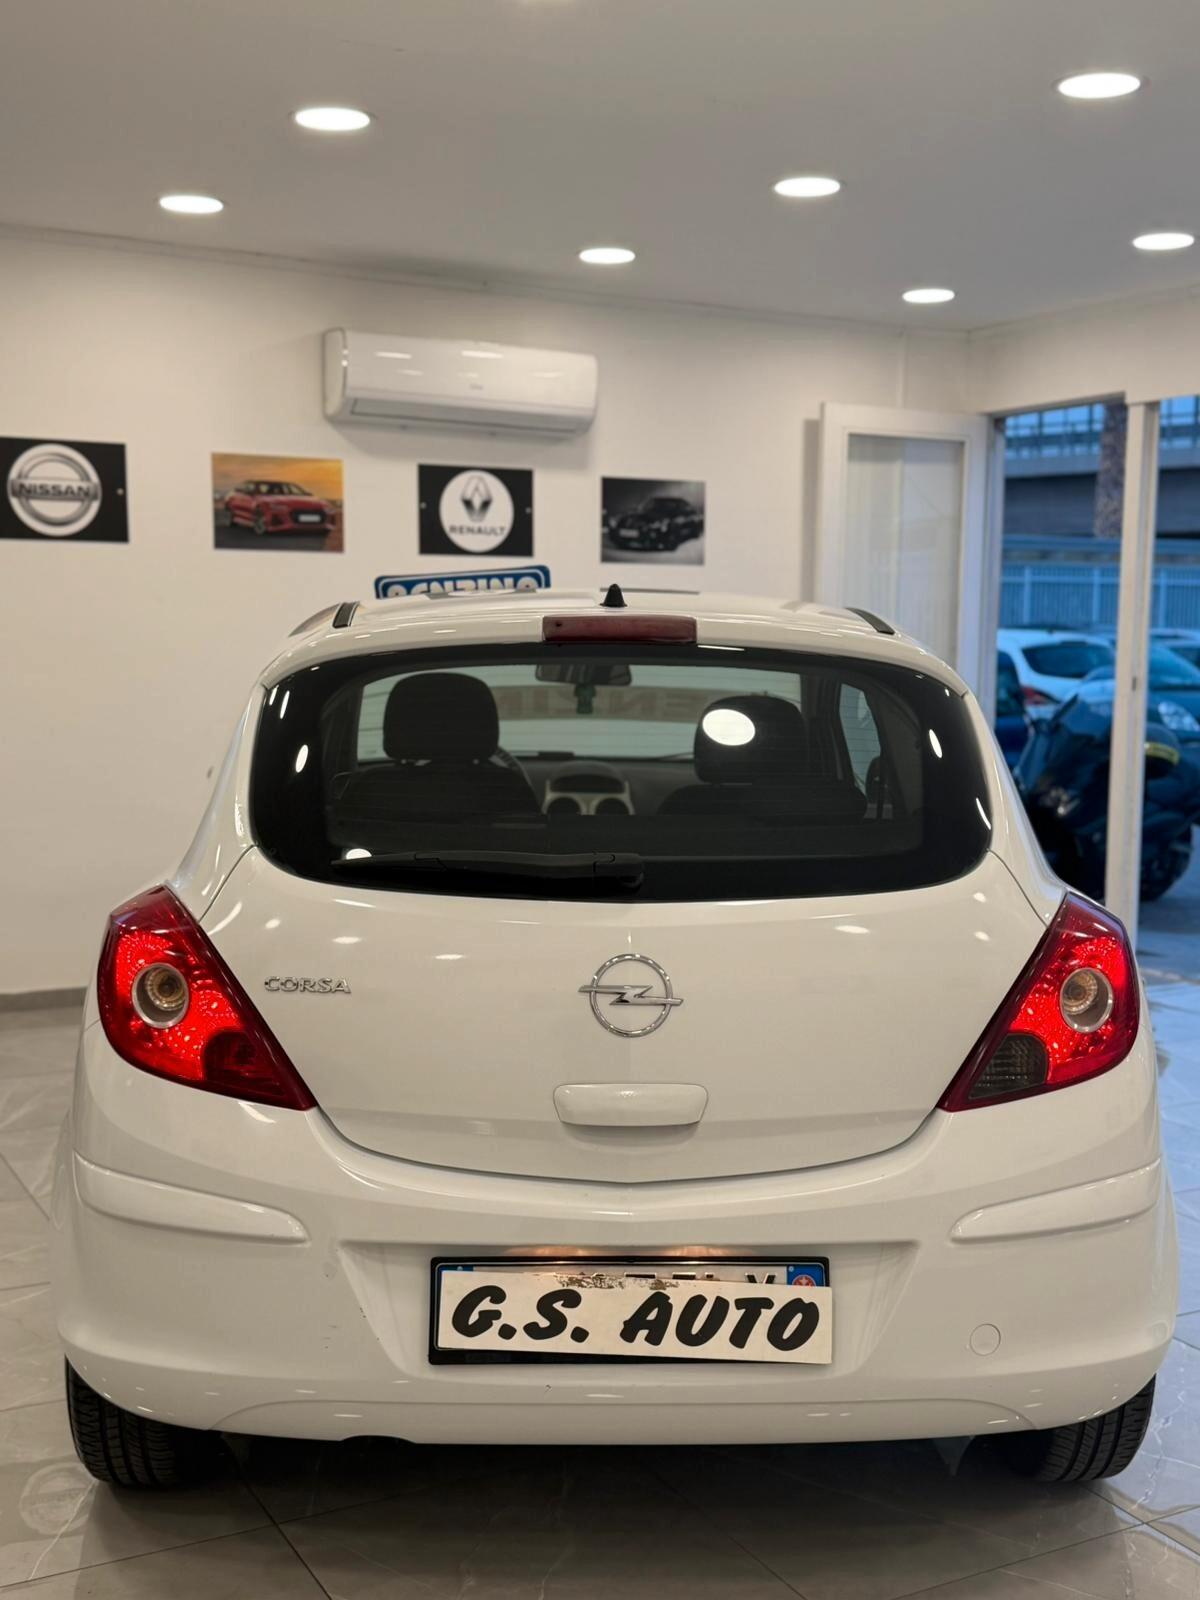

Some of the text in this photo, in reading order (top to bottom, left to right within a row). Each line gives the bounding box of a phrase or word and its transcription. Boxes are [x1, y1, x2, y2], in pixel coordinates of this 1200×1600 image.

[19, 483, 90, 497] NISSAN
[449, 525, 505, 536] RENAULT
[264, 976, 351, 994] CORSA
[452, 1285, 820, 1351] G.S. AUTO
